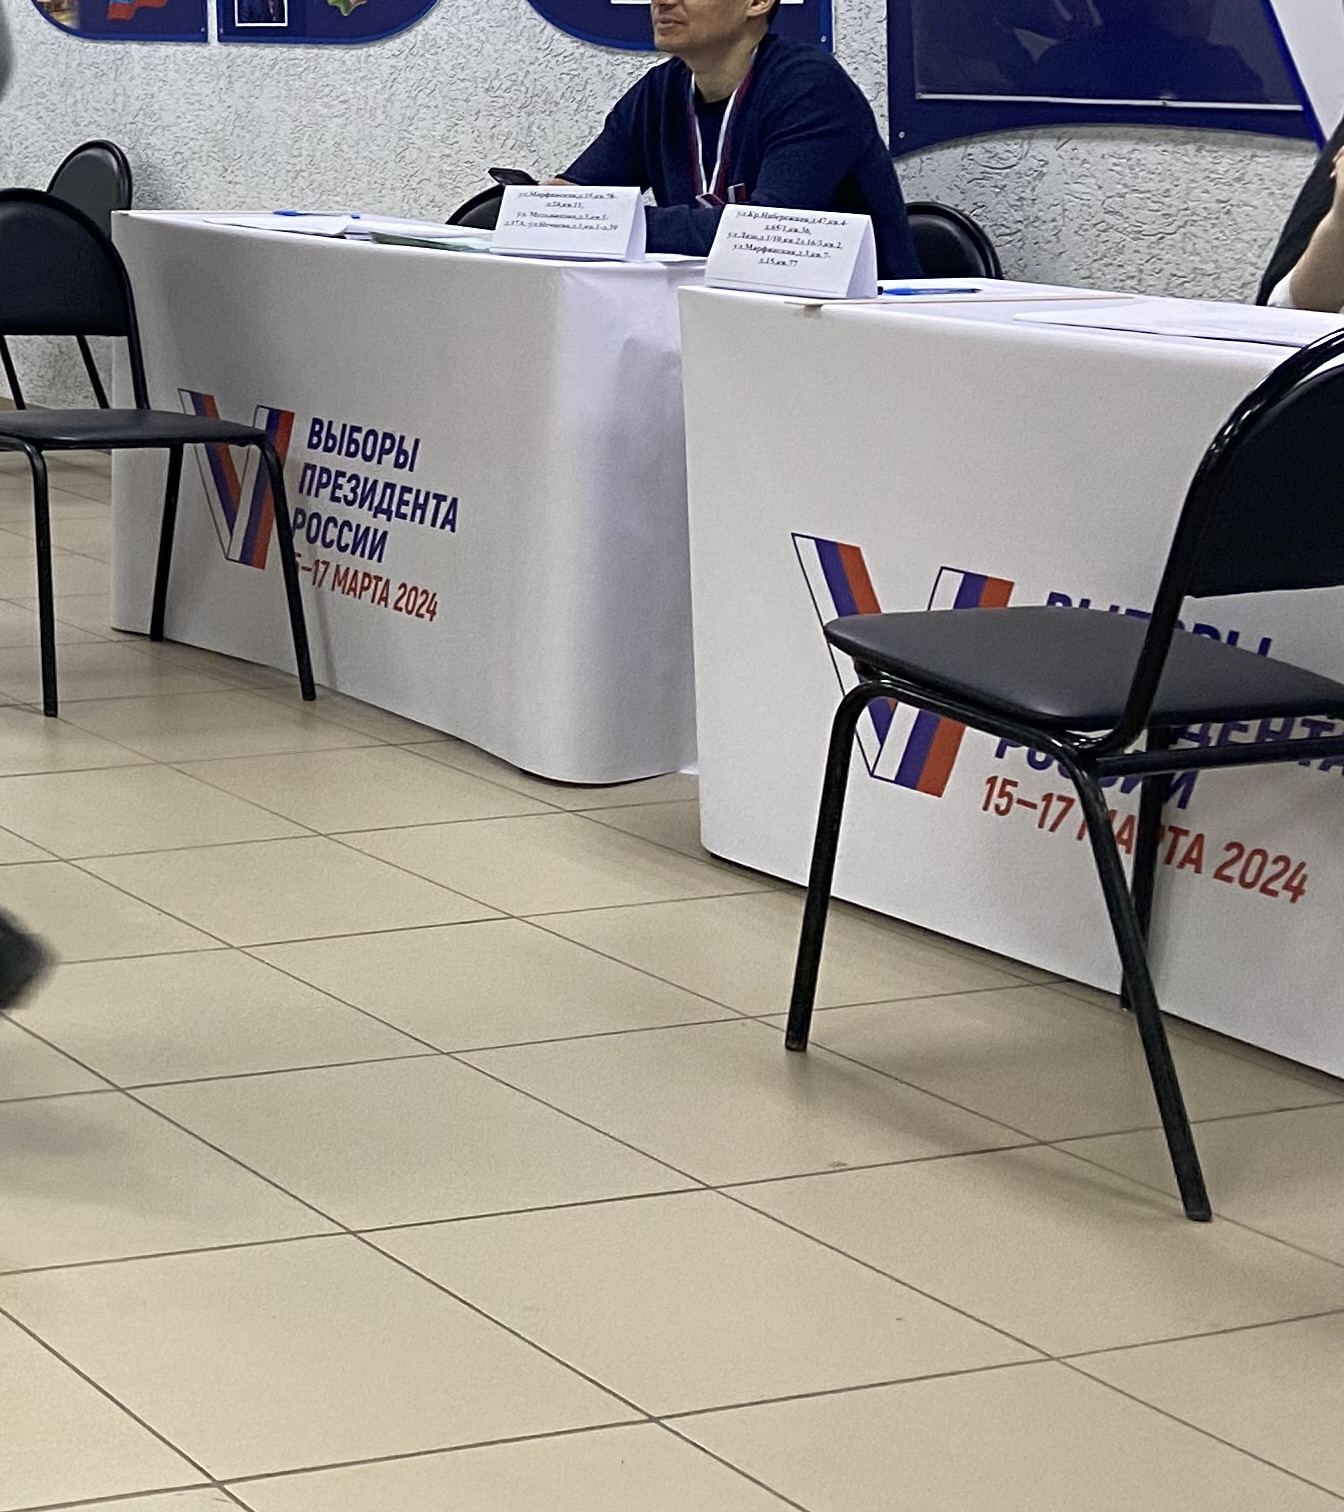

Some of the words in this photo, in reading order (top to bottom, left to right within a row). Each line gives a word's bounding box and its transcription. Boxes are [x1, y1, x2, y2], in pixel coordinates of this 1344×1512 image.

[307, 417, 420, 472] ВЫБОРЫ
[298, 462, 458, 533] ПРЕЗИДЕНТА
[292, 507, 389, 563] РОССИИ
[331, 564, 391, 608] МАРТА
[393, 582, 438, 622] 2024
[1076, 808, 1204, 874] АТА
[1212, 841, 1309, 904] 2024
